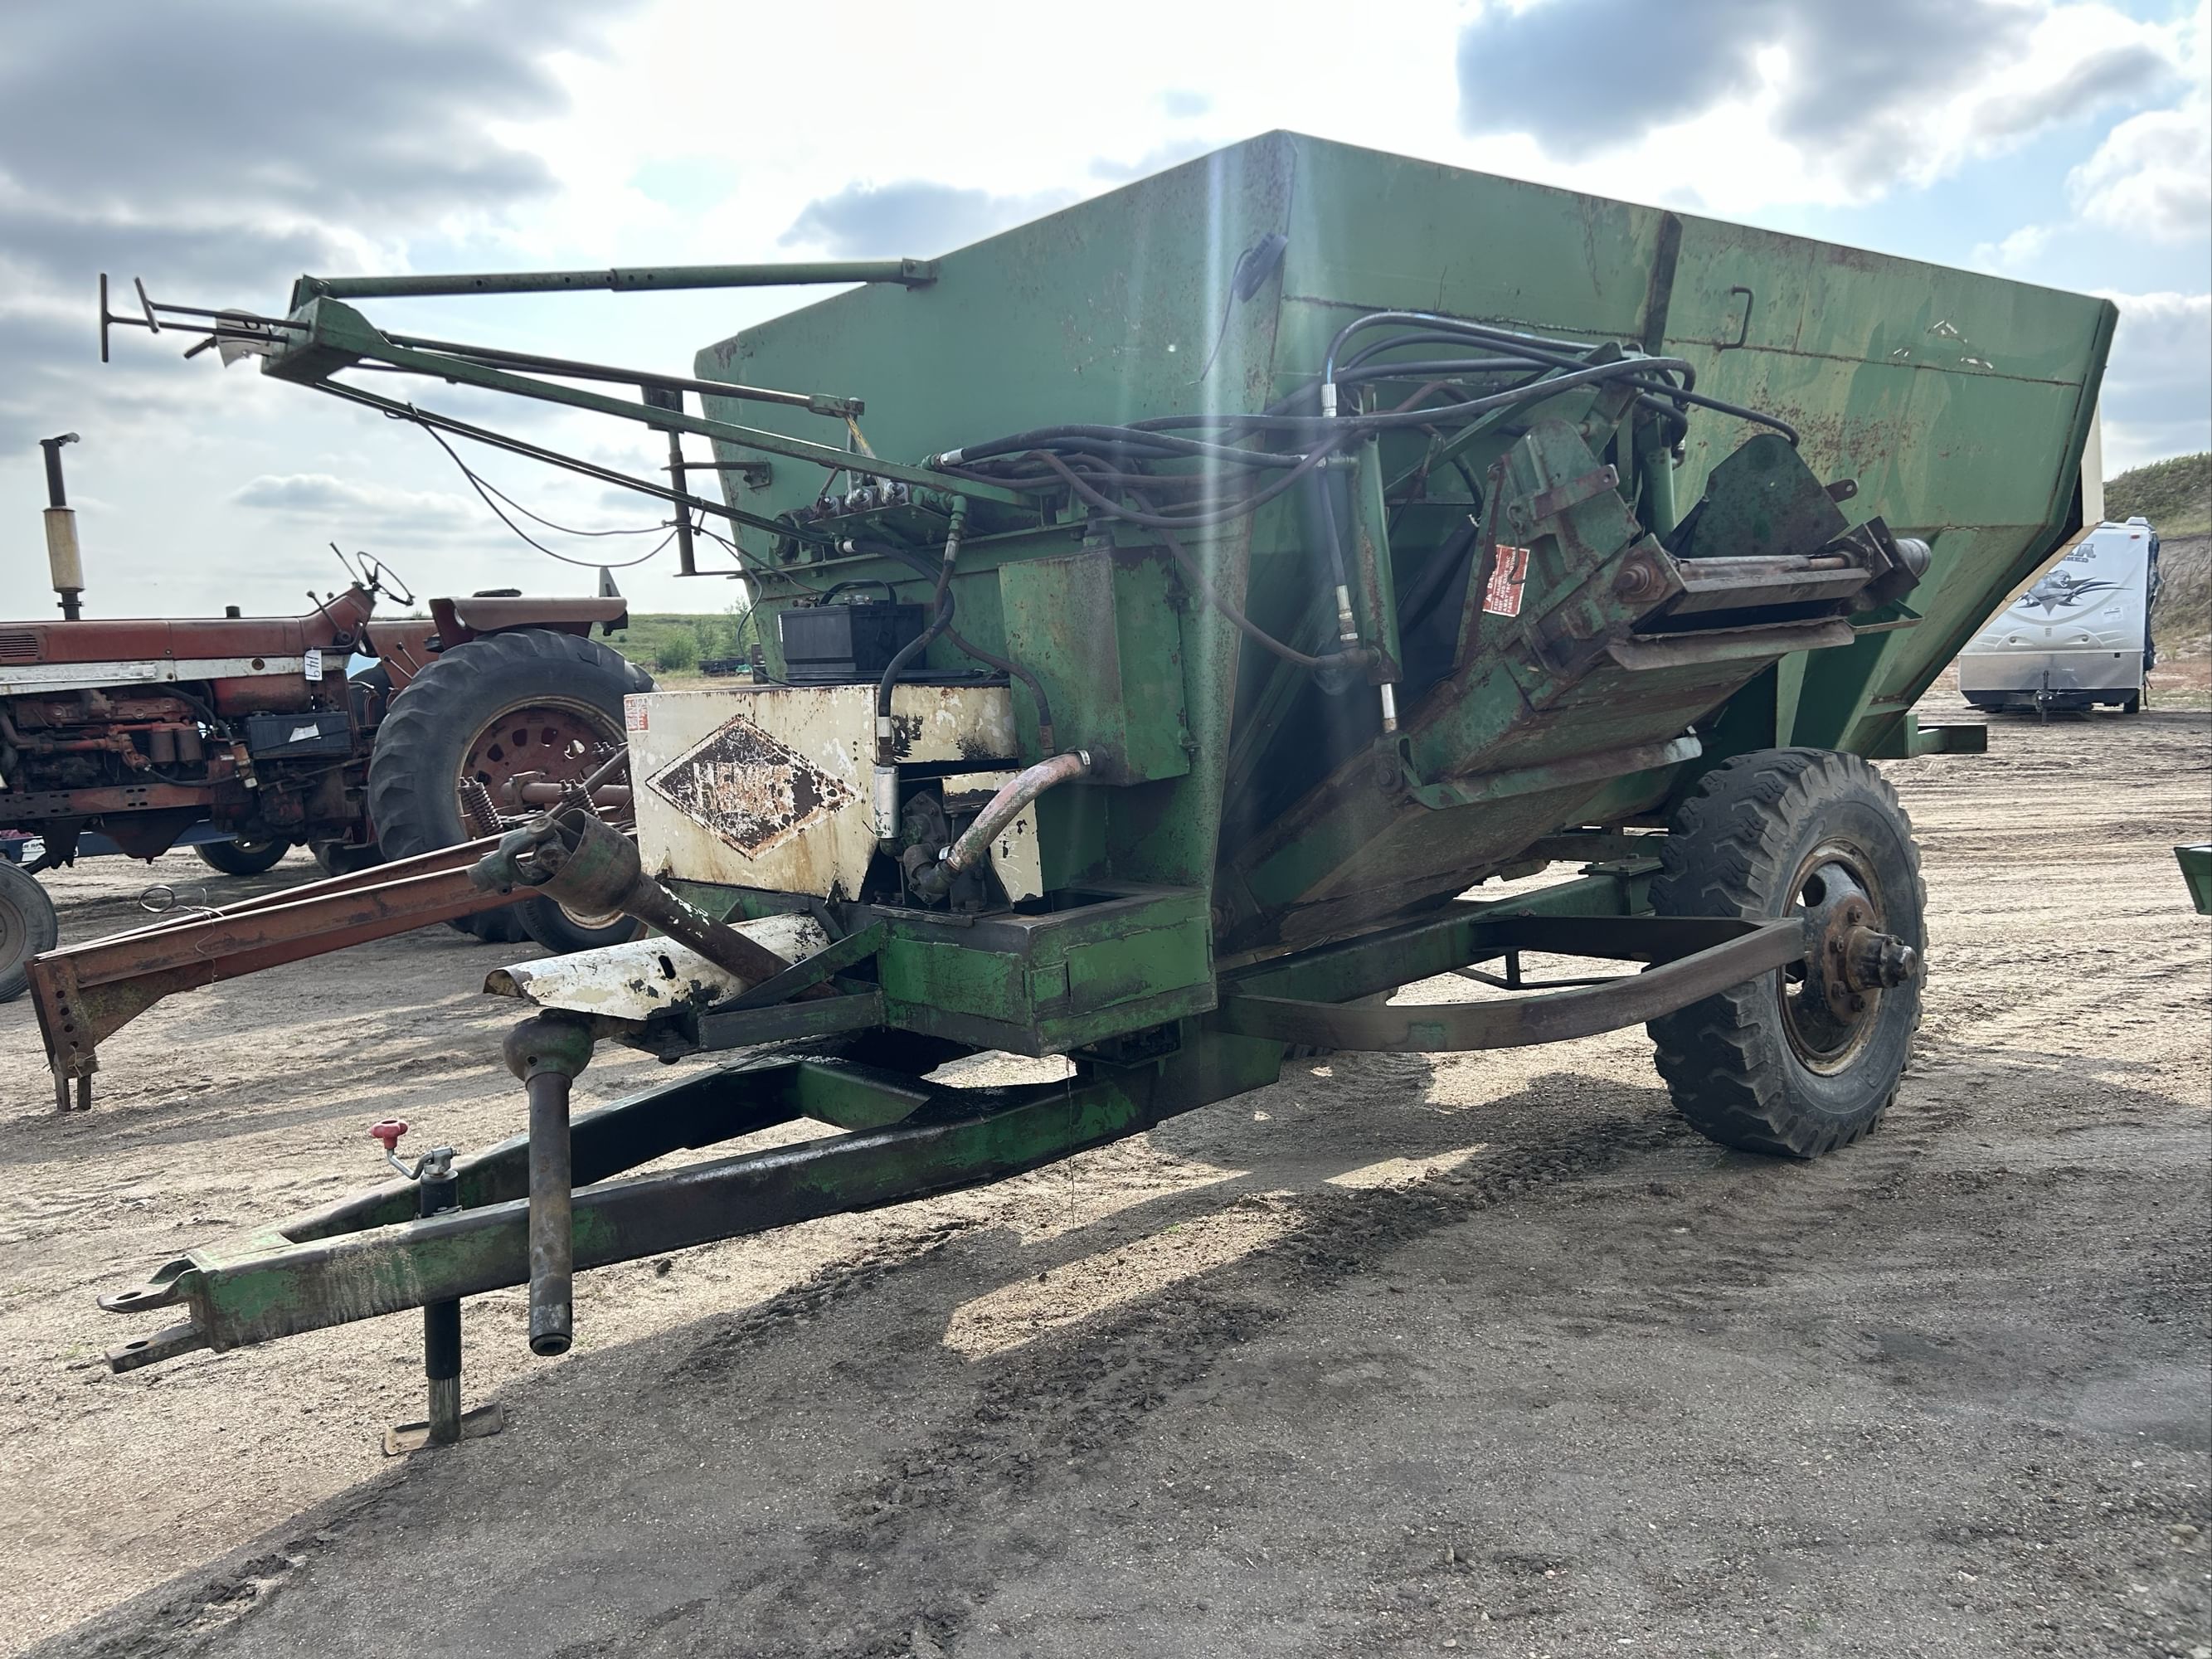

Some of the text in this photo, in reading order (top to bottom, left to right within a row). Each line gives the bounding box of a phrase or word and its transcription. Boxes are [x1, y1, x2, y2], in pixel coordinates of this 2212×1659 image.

[1502, 556, 1510, 584] CLOTING
[3, 665, 156, 682] ARMALL
[305, 656, 320, 677] 149
